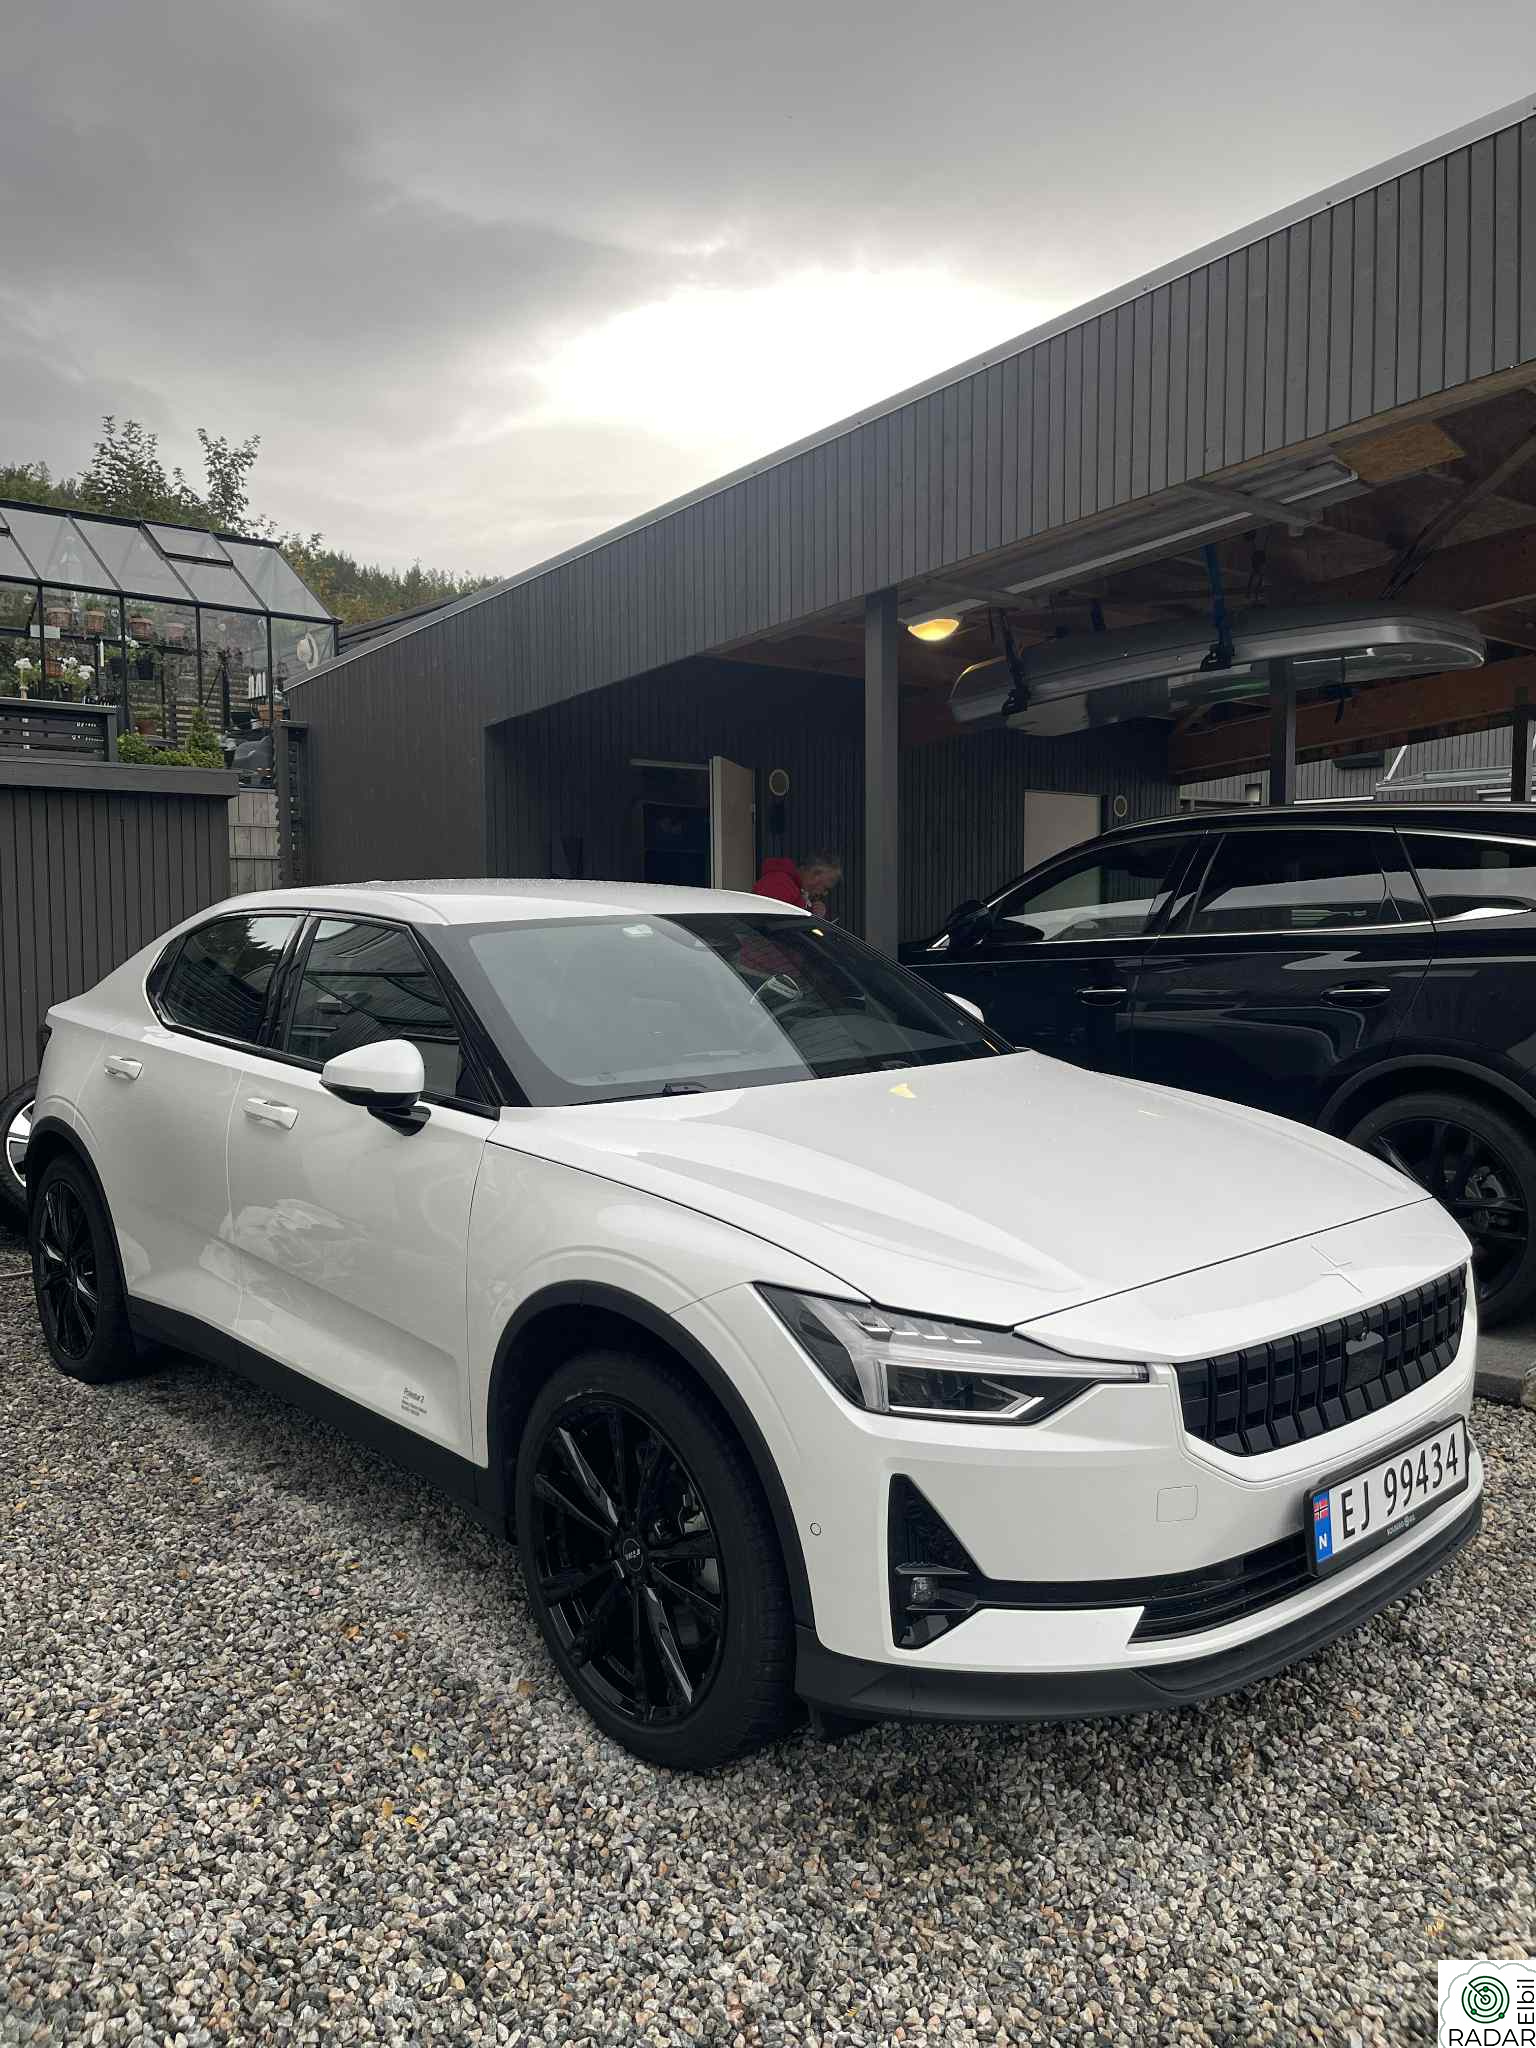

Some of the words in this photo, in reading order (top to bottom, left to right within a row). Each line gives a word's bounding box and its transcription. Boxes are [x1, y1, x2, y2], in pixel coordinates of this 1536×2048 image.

[1341, 1480, 1371, 1540] EJ
[1383, 1432, 1458, 1517] 99434
[1318, 1534, 1328, 1550] N
